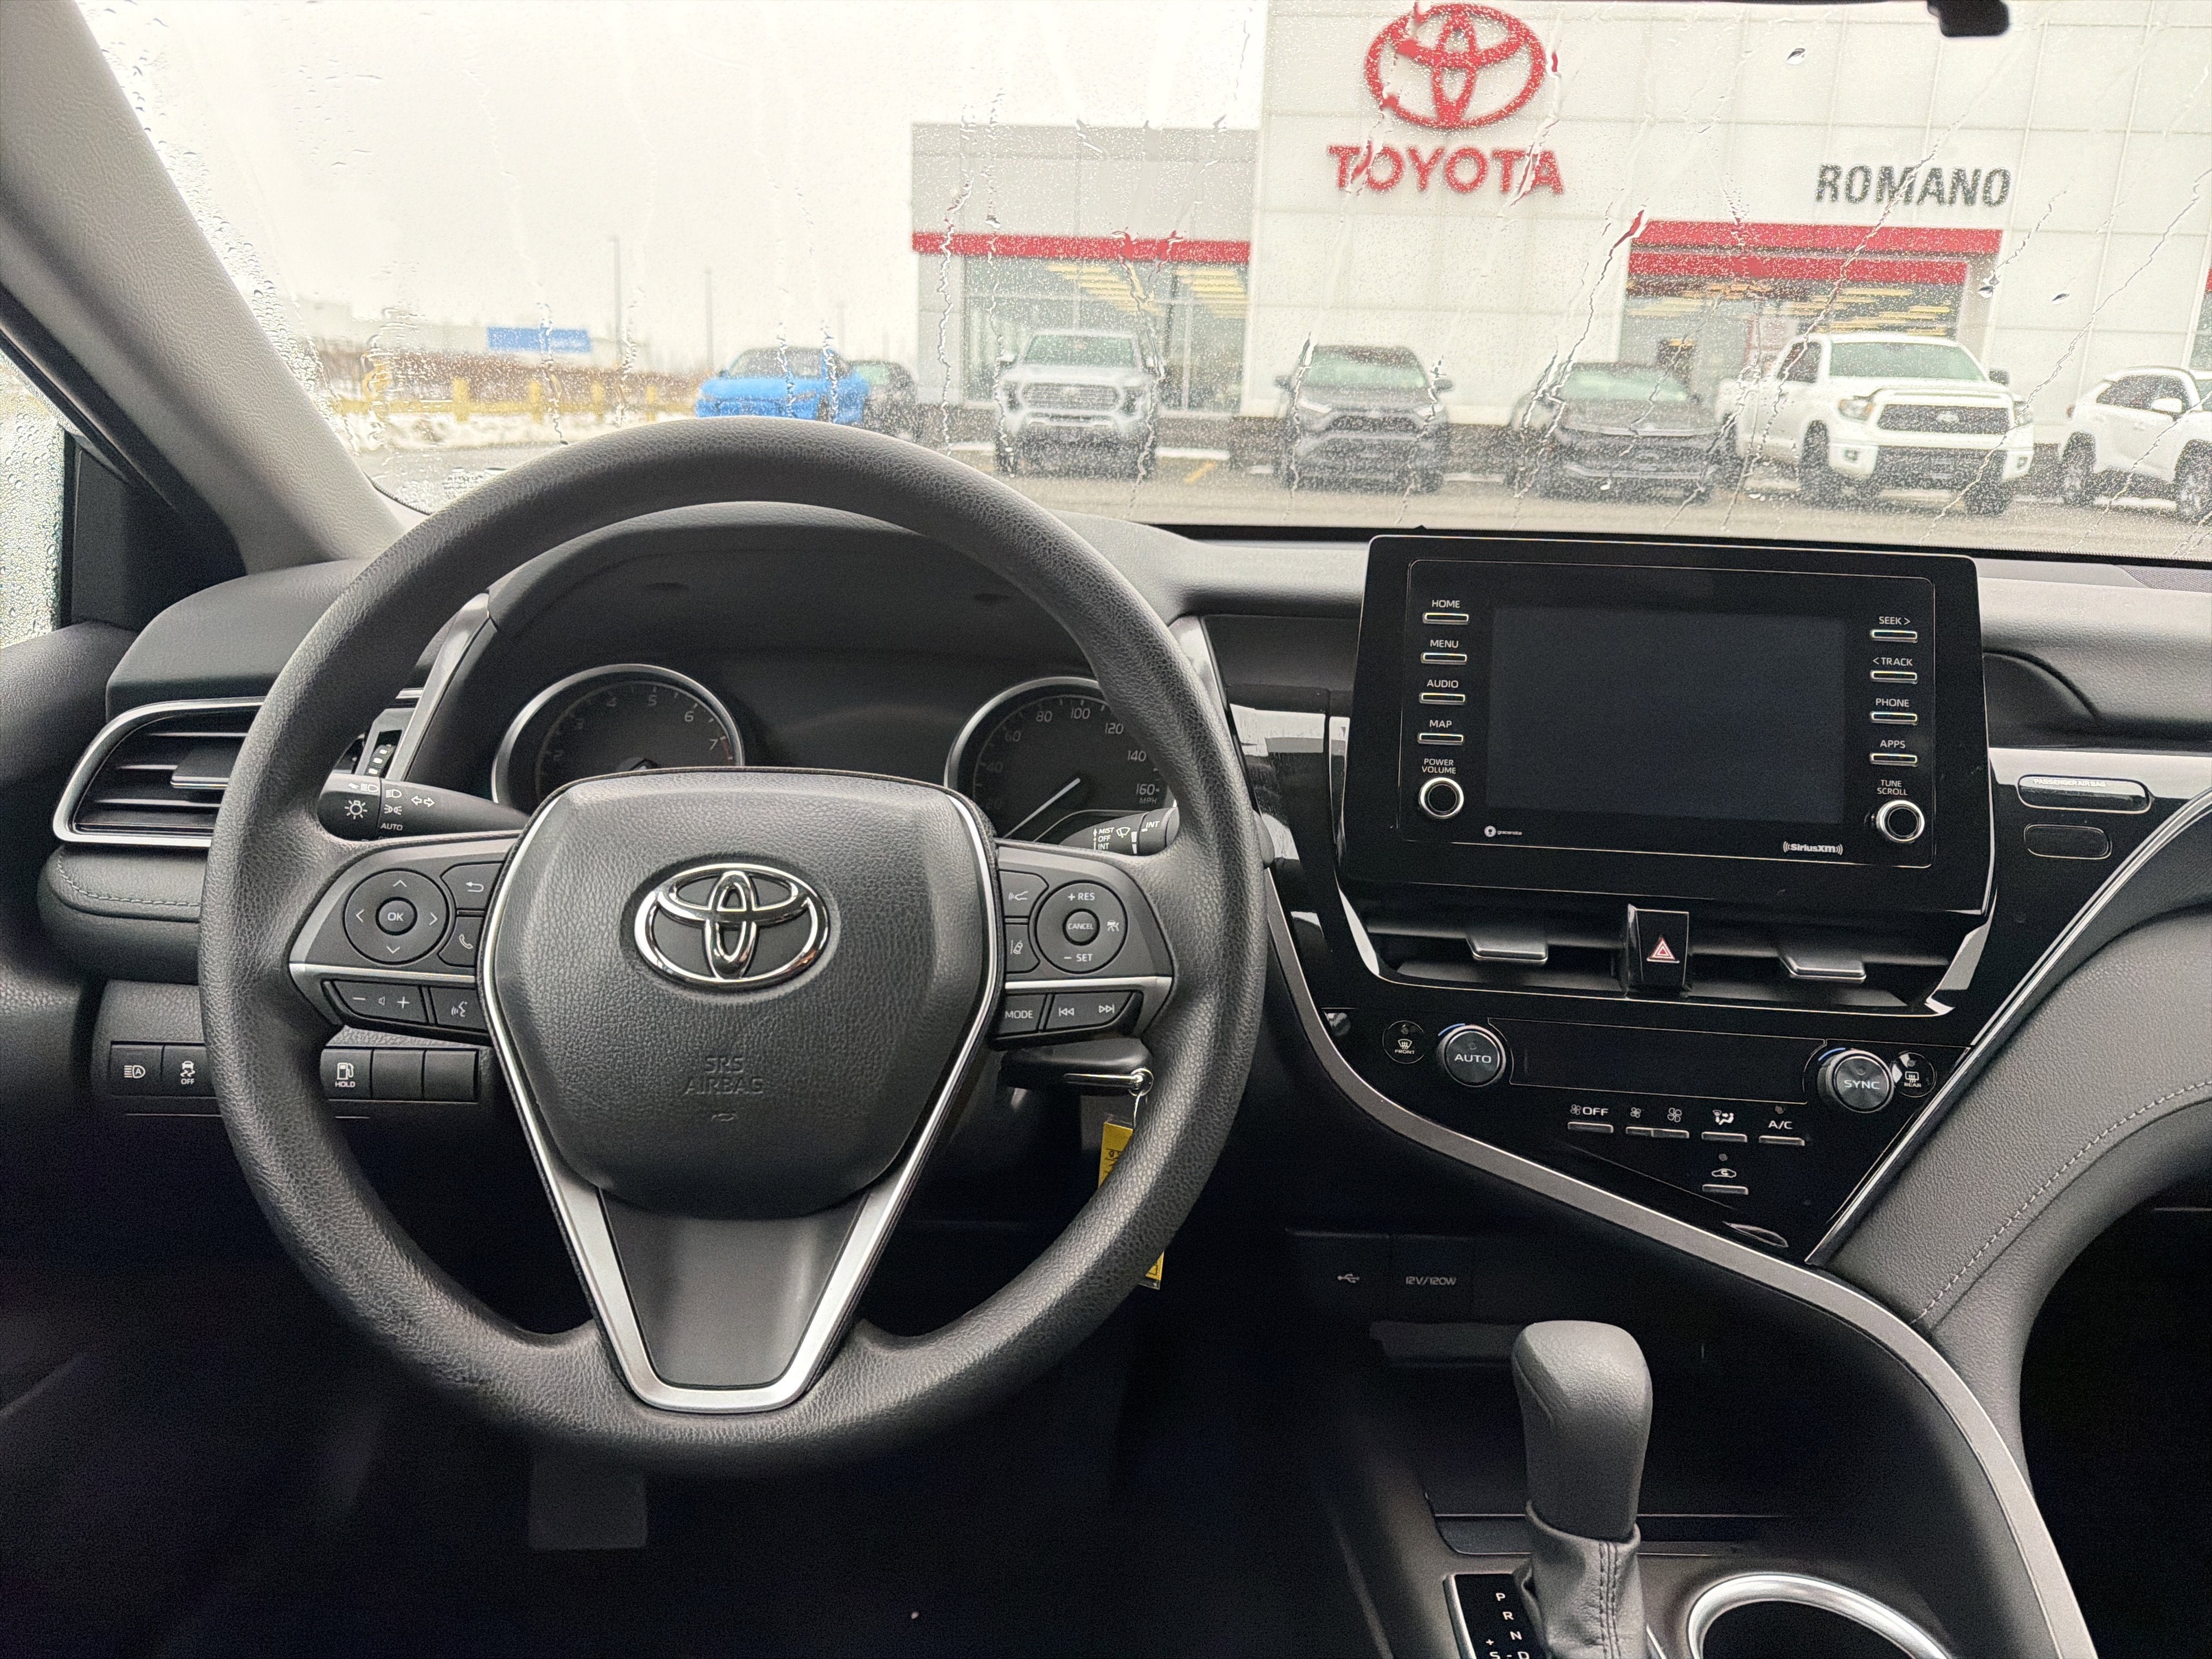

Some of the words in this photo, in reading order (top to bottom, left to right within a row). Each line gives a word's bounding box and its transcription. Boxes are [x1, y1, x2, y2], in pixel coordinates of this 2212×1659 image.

[1327, 144, 1564, 195] TOYOTA
[1815, 163, 2011, 207] ROMANO
[1431, 600, 1460, 608] HOME
[1430, 639, 1459, 648] MENU
[1426, 679, 1459, 688] AUDIO
[647, 694, 658, 707] 5
[1876, 698, 1910, 707] PHONE
[684, 711, 694, 723] 6
[1036, 710, 1053, 723] 80
[1070, 707, 1091, 720] 100
[1429, 720, 1452, 728] MAP
[1105, 723, 1124, 735] 120
[1005, 730, 1022, 742] 60
[707, 738, 719, 751] 7
[1880, 740, 1905, 749] APPS
[1127, 750, 1147, 762] 140
[1421, 766, 1457, 774] VOLUME
[1136, 783, 1155, 795] 160
[1877, 787, 1908, 795] SCROLL
[380, 823, 403, 831] AUTO
[388, 912, 404, 921] OK
[1005, 1010, 1034, 1019] MODE
[1454, 1053, 1492, 1064] AUTO
[1843, 1079, 1880, 1090] SYNC
[1582, 1108, 1609, 1116] OFF
[1768, 1120, 1793, 1130] A/C
[1406, 1276, 1457, 1285] 12V/120W
[1496, 1593, 1506, 1601] P
[1502, 1611, 1514, 1620] R
[1510, 1631, 1522, 1640] N
